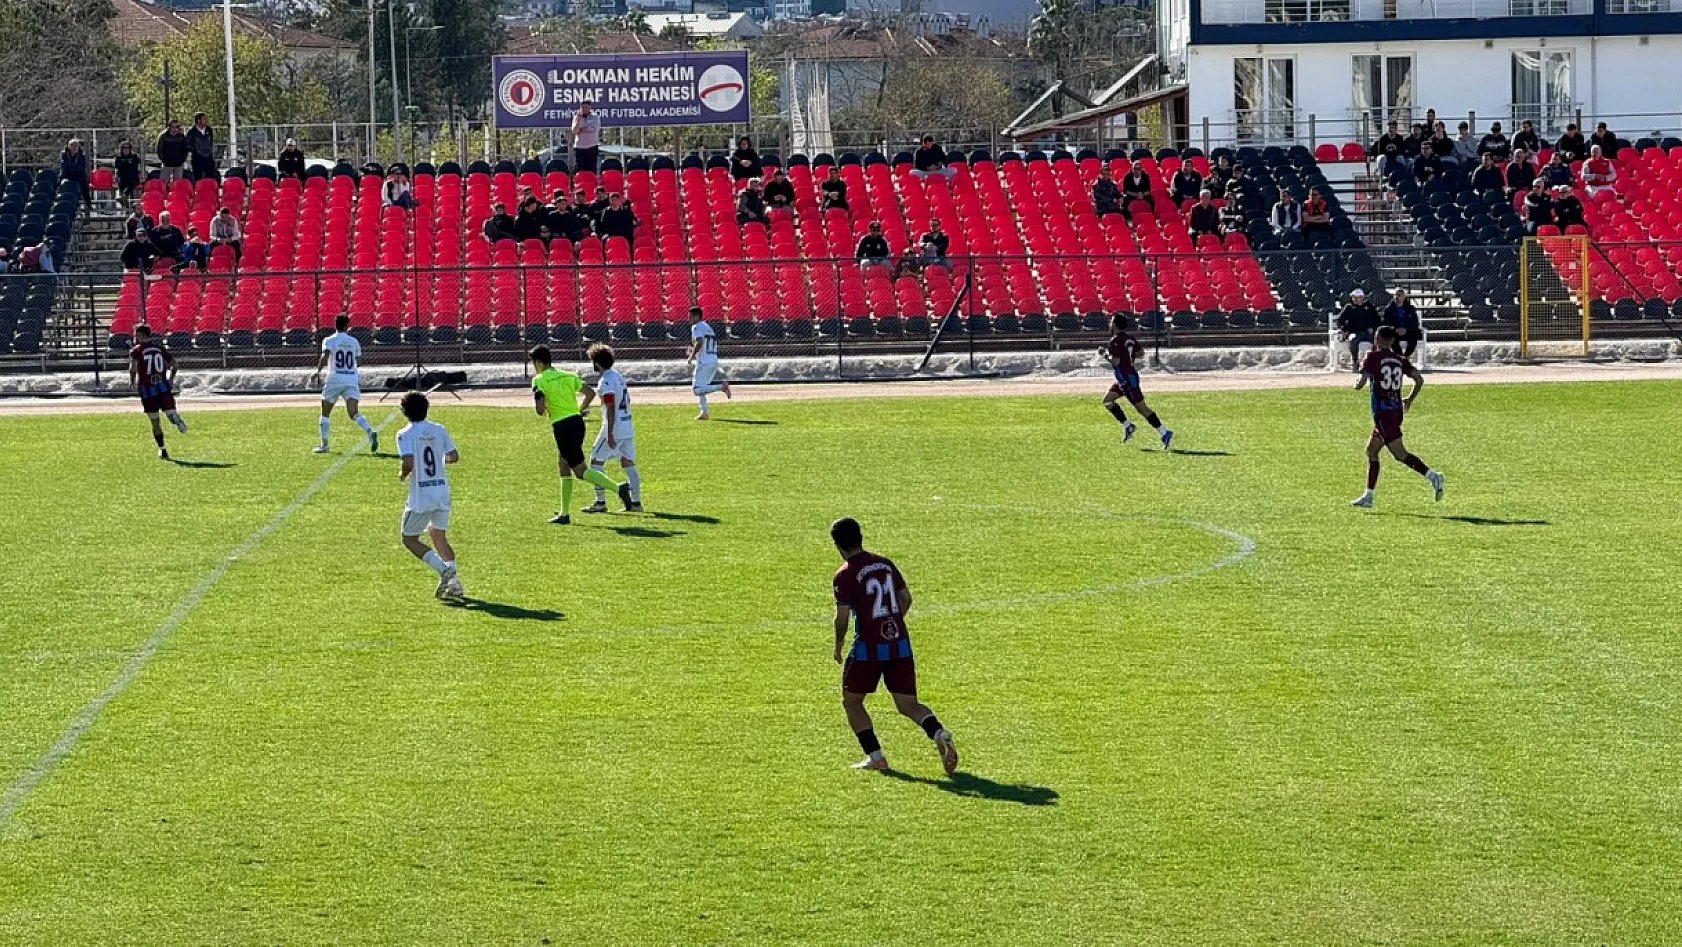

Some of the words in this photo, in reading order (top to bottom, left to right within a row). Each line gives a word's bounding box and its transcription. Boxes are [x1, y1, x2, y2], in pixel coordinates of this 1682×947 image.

[553, 68, 630, 84] LOKMAN
[636, 63, 694, 82] HEKİM
[553, 87, 604, 103] ESNAF
[608, 82, 695, 103] HASTANESİ
[611, 108, 648, 118] FUTBOL
[649, 105, 701, 117] AKADEMİSİ
[143, 353, 164, 375] 70
[335, 350, 353, 369] 90
[1380, 365, 1402, 390] 33
[423, 446, 436, 477] 9
[866, 573, 899, 619] 21
